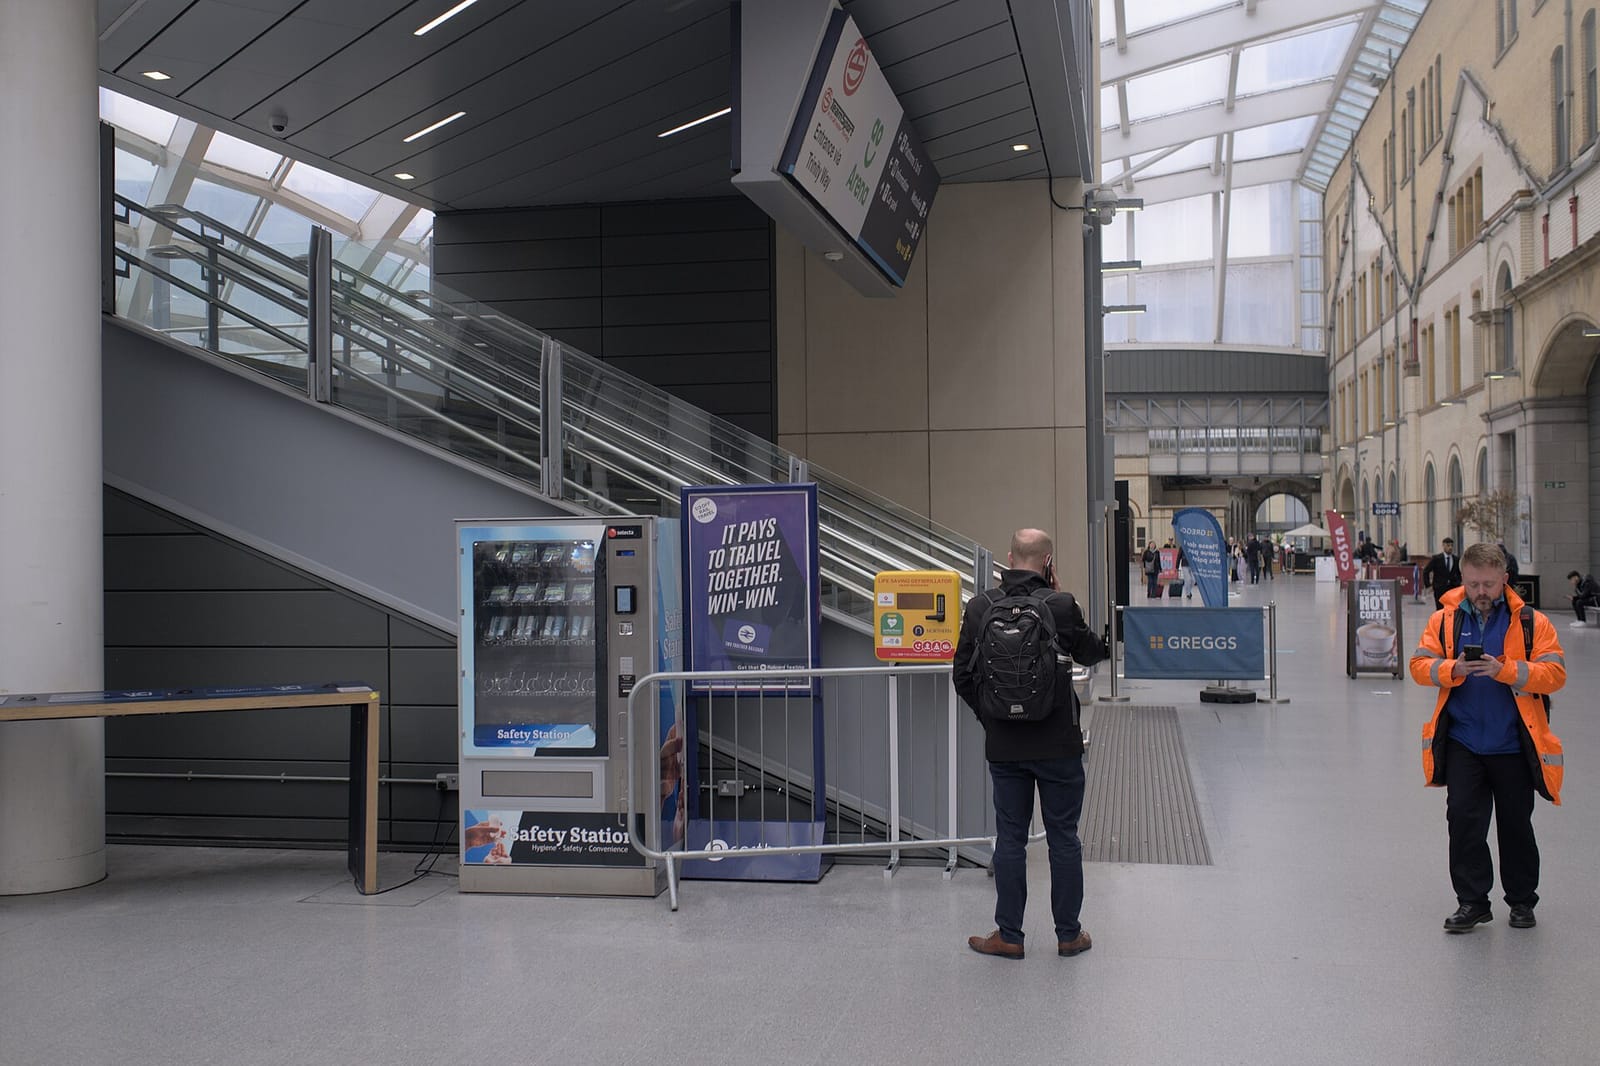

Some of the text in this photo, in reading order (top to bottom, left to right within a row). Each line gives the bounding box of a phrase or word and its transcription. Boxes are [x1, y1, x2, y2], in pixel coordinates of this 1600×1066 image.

[814, 123, 834, 158] Entrance
[833, 150, 842, 166] via
[805, 152, 831, 192] Trinity Way
[846, 164, 870, 206] Arena
[722, 518, 776, 545] IT PAYS
[708, 540, 781, 570] TO TRAVEL
[1335, 526, 1350, 571] COSTA
[708, 562, 782, 592] TOGETHER.
[708, 586, 778, 616] WIN-WIN.
[1360, 596, 1390, 610] HOT
[1360, 611, 1391, 619] COFFEE
[1168, 636, 1236, 650] GREGGS
[498, 729, 570, 741] Safety Station
[510, 825, 566, 846] Safety
[532, 844, 628, 854] Hygiene Safety Convenience
